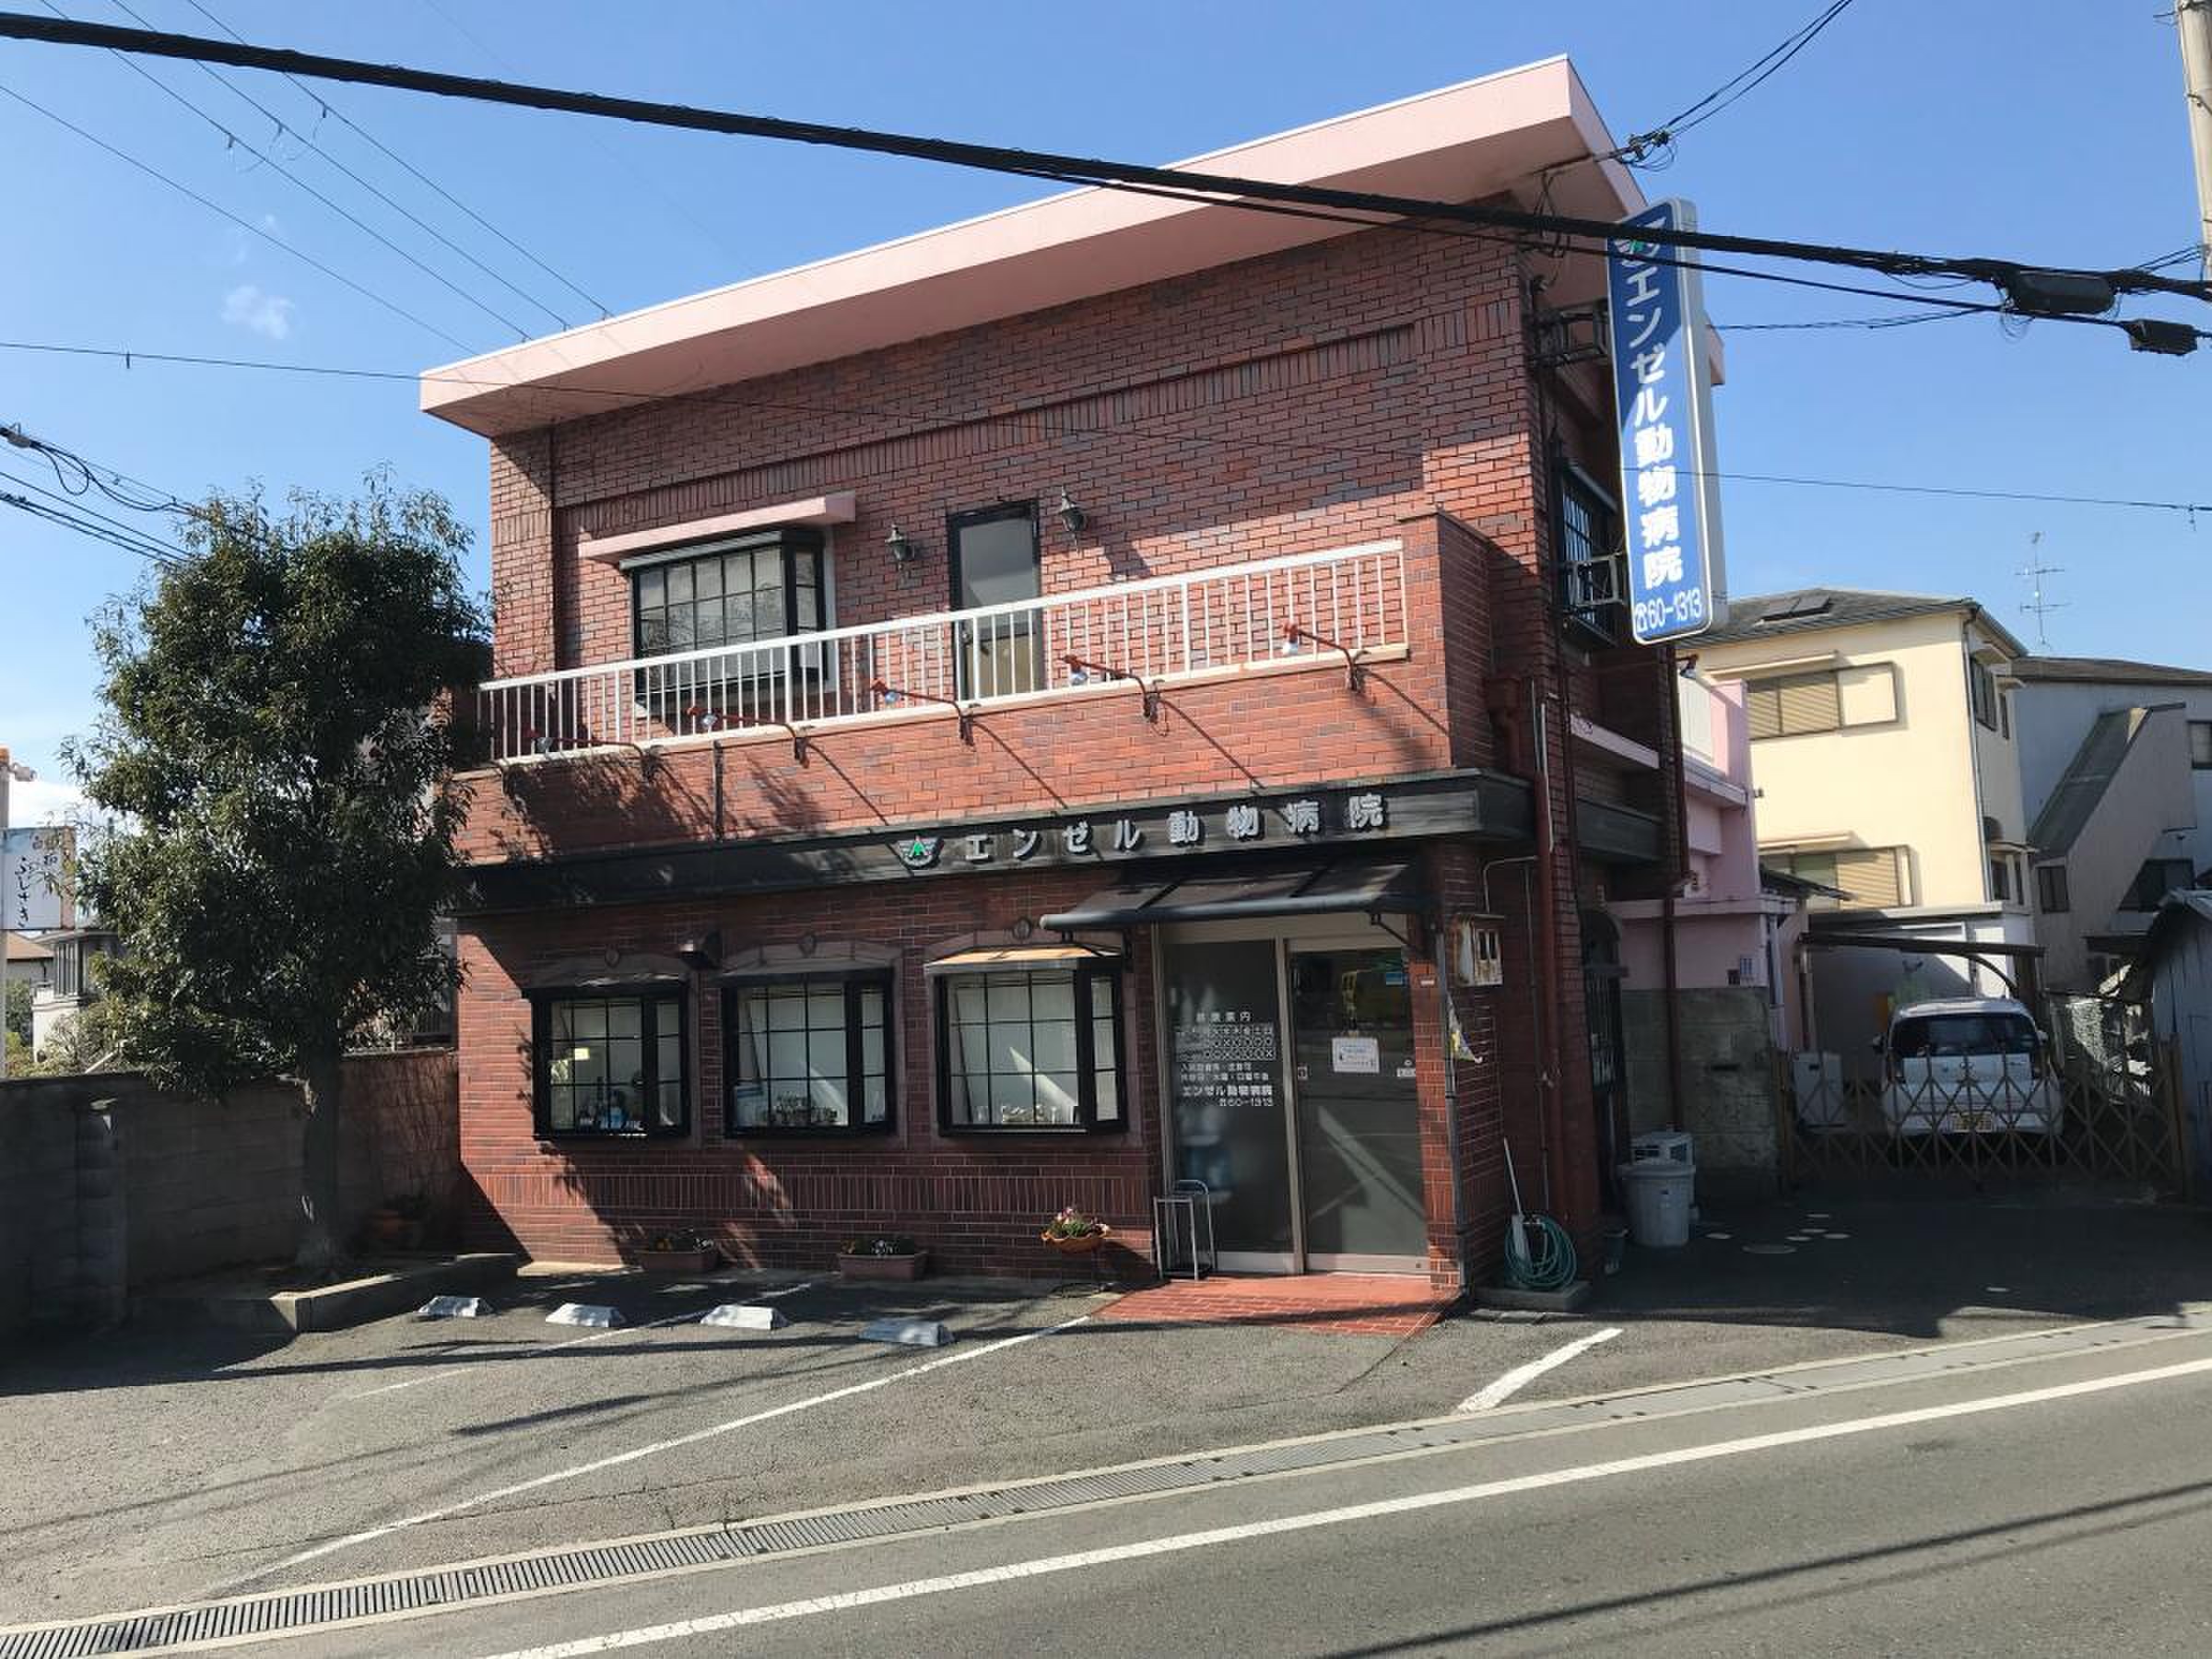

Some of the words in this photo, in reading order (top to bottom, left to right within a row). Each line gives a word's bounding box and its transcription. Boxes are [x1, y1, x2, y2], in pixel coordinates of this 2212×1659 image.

[1626, 265, 1684, 589] エンゼル動物病院
[966, 793, 1383, 860] エンゼル動物病院
